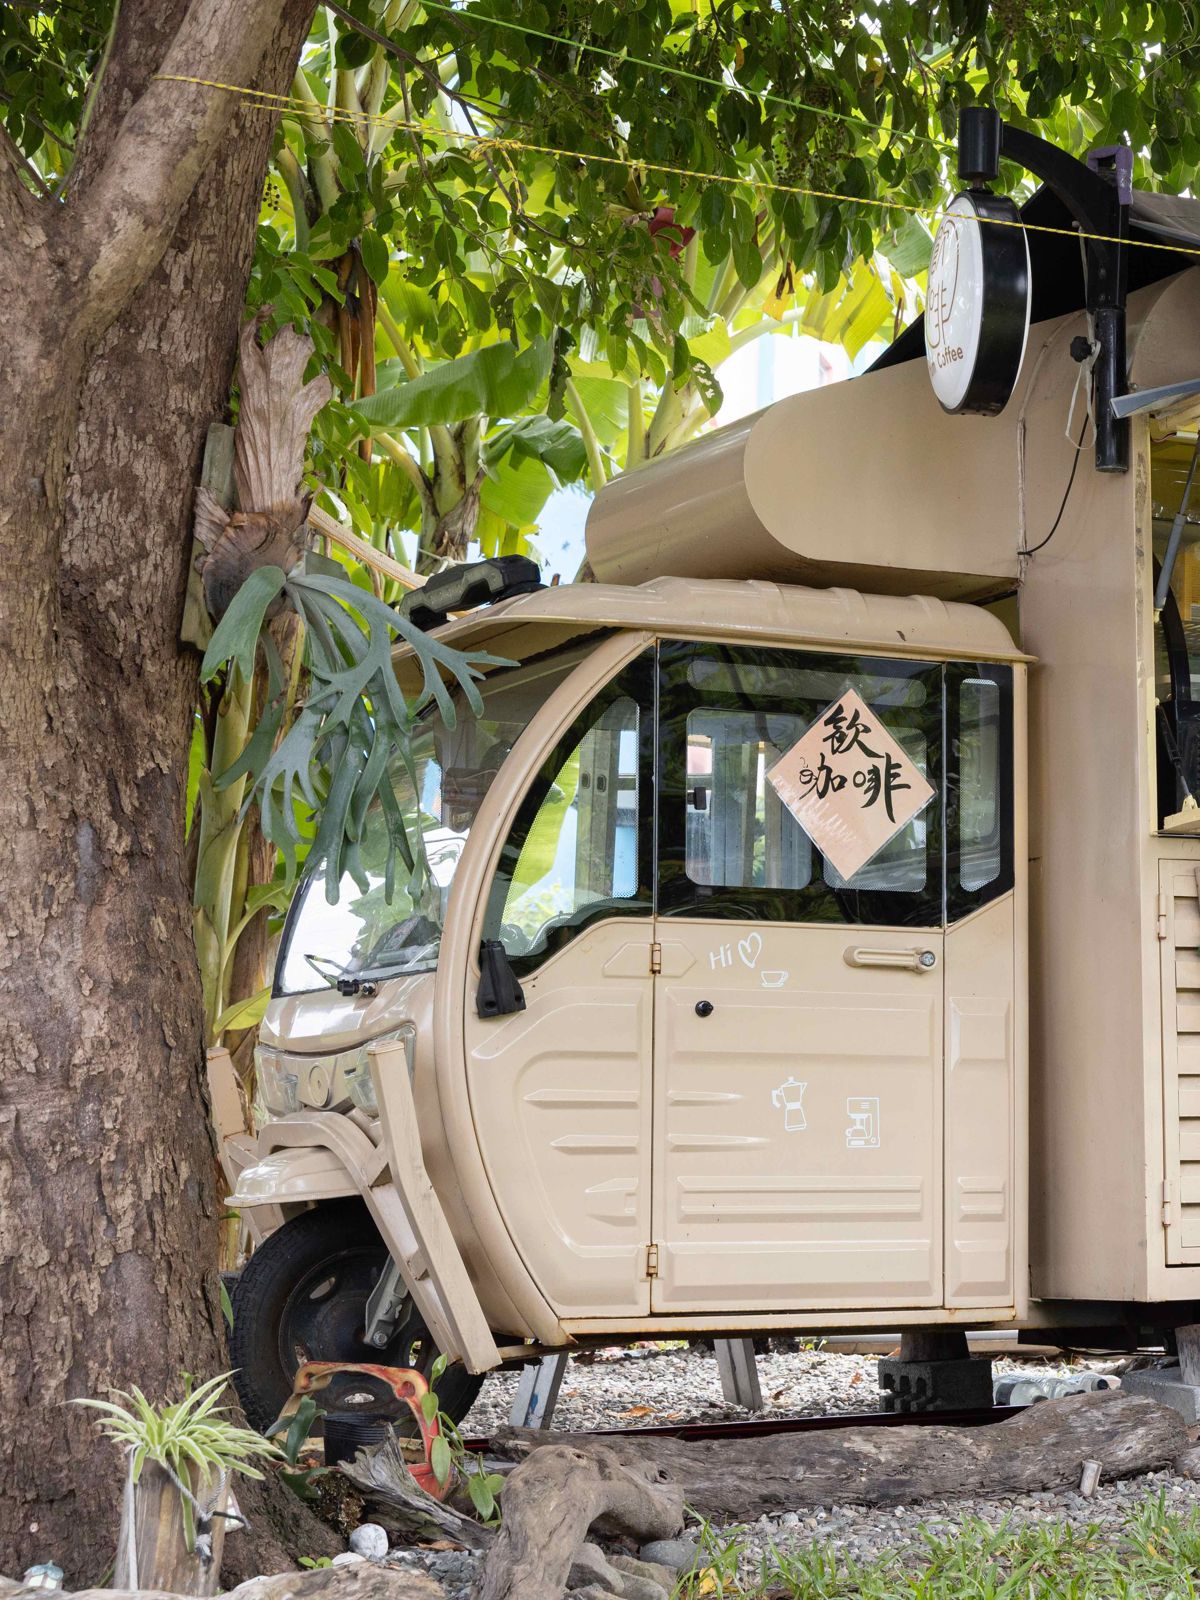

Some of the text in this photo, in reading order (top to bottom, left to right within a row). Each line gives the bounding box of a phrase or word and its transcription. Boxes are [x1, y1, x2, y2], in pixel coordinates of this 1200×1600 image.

[937, 346, 964, 368] Coffee
[823, 703, 885, 759] 飲
[800, 752, 912, 824] 咖啡
[709, 943, 733, 970] Hi
